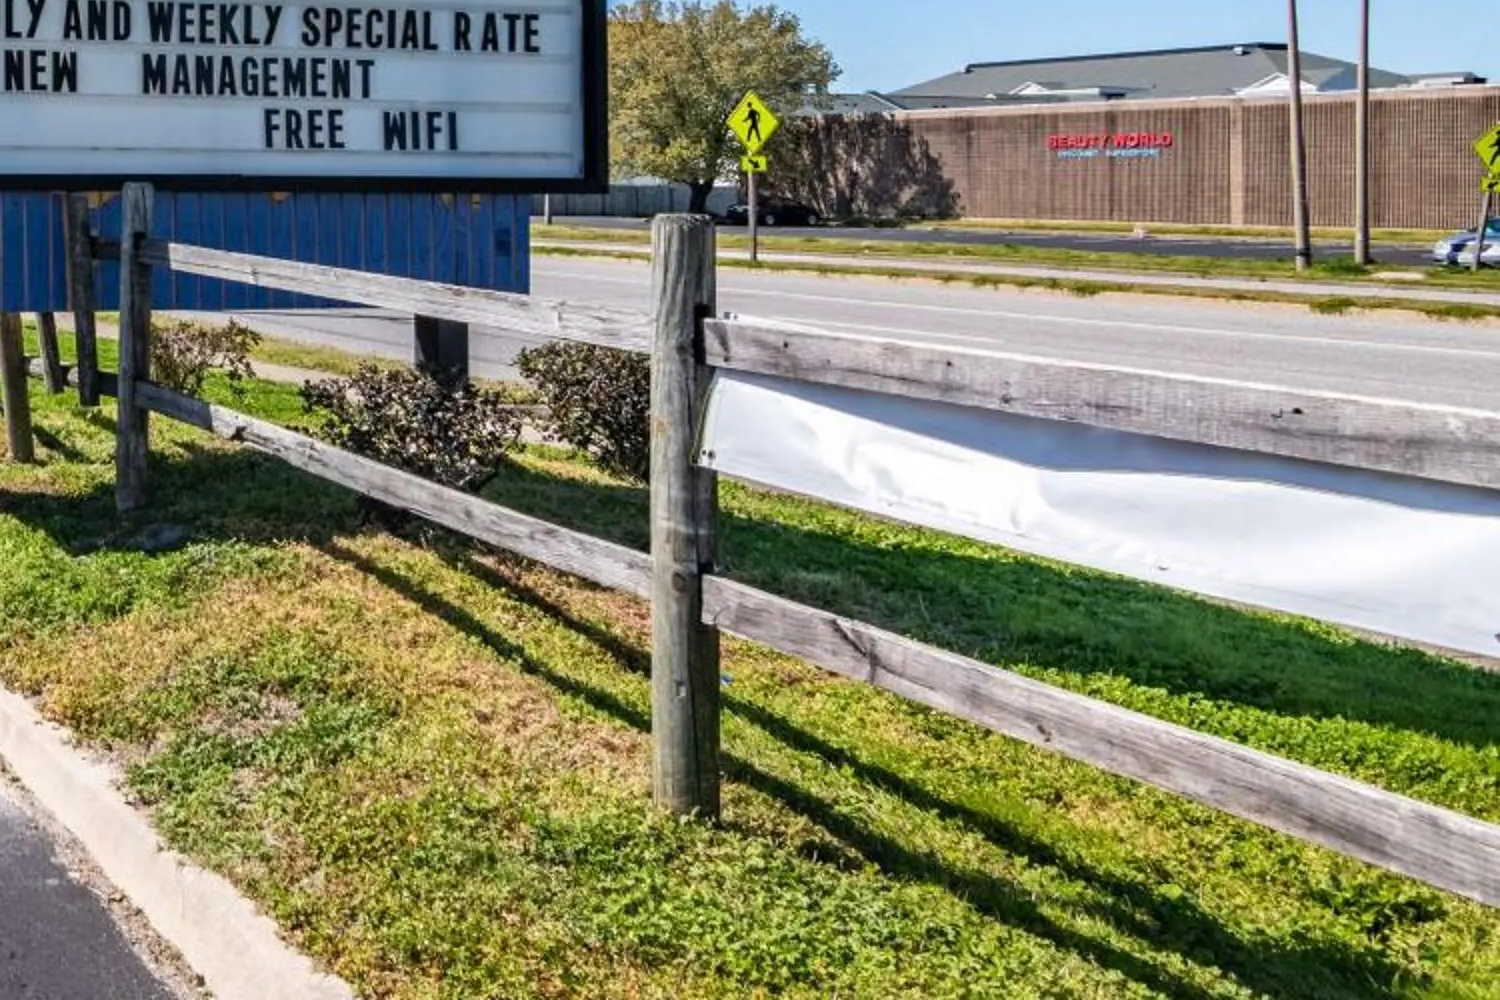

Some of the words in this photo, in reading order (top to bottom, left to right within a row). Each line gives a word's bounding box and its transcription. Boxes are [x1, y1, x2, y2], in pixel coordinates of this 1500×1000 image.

[146, 0, 284, 47] WEEKLY
[301, 5, 440, 52] SPECIAL
[453, 10, 541, 54] RATE
[3, 49, 78, 94] NEW
[141, 52, 376, 100] MANAGEMENT
[263, 108, 346, 150] FREE
[382, 110, 459, 152] WIFI
[1047, 134, 1108, 148] BEAUTY
[1113, 131, 1172, 148] WORLD
